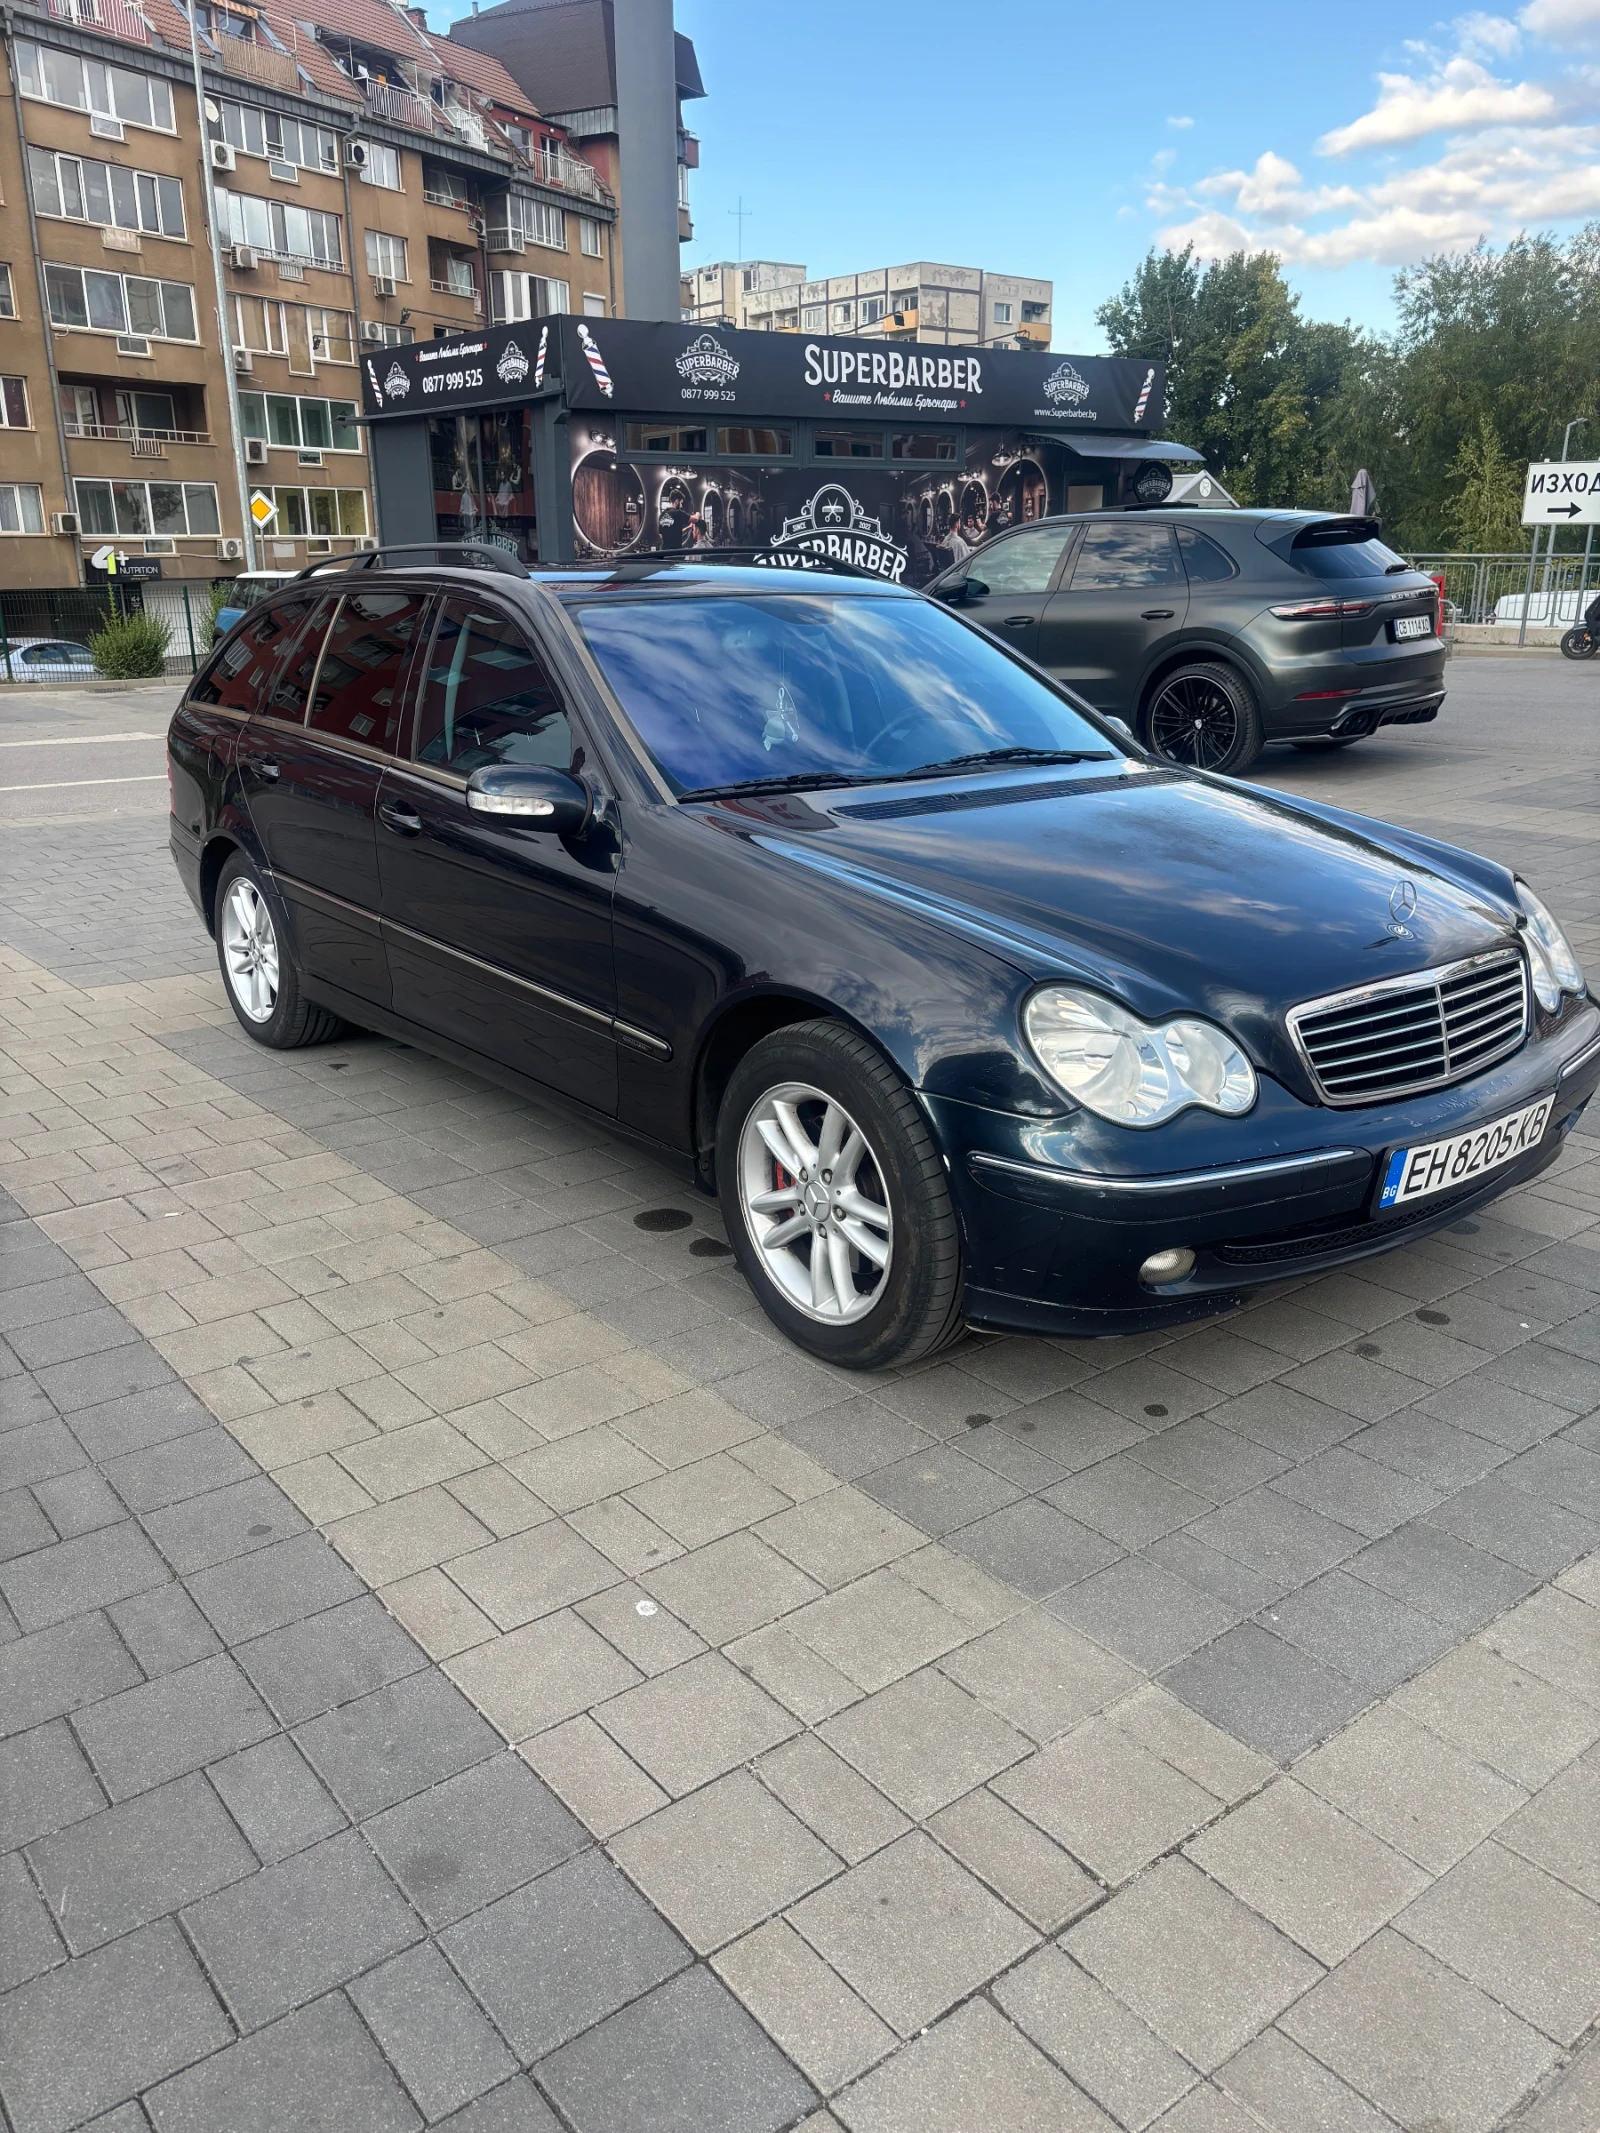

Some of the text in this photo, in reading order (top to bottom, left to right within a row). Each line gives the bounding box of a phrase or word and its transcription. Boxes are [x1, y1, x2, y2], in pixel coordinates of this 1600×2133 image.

[676, 354, 740, 379] SUPERBARBER
[804, 343, 983, 395] SUPERBARBER
[422, 368, 483, 393] 0877 999 525
[681, 388, 736, 401] 0877 999 525
[832, 389, 958, 412] Вашите Любими Бръснари
[119, 566, 159, 574] NUTRITION
[1382, 1185, 1397, 1200] BG
